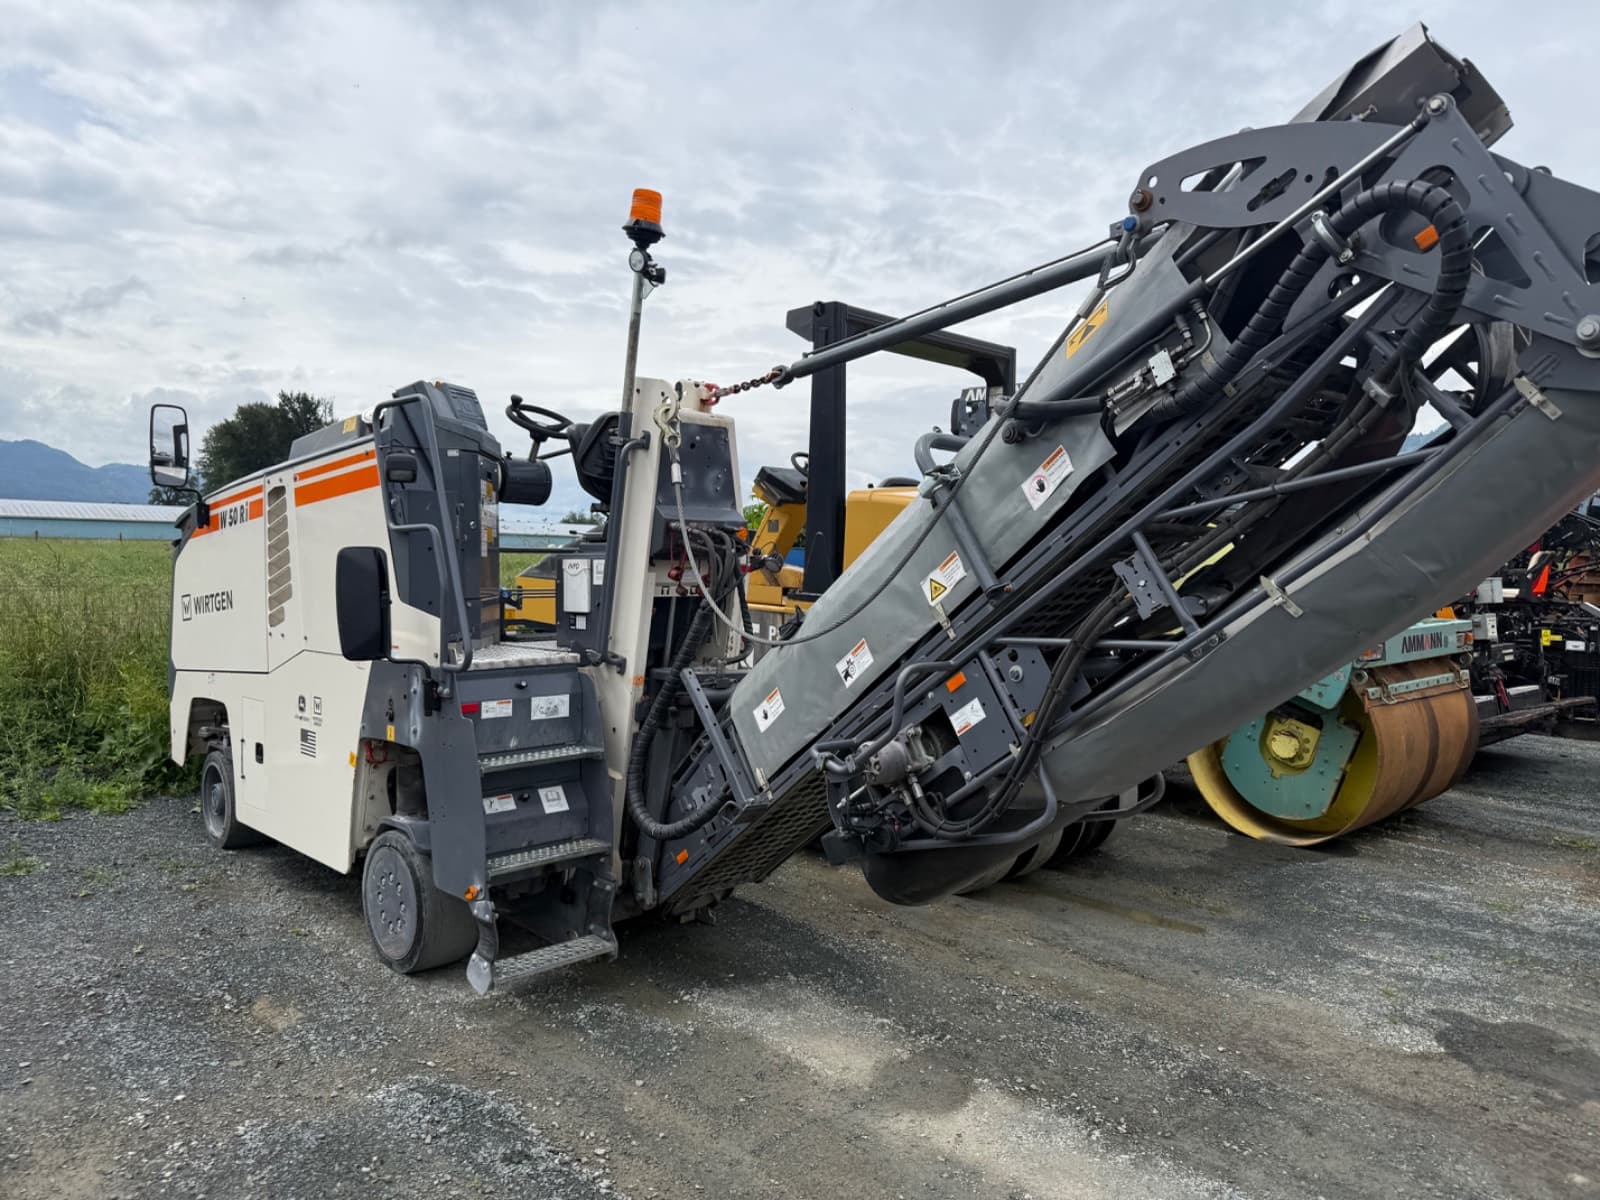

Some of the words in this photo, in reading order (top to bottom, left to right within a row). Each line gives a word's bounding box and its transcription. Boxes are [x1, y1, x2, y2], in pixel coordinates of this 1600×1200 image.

[220, 510, 228, 529] W
[229, 506, 239, 527] 50
[240, 501, 249, 524] Ri
[193, 590, 233, 615] WIRTGEN
[1401, 631, 1443, 654] AMMANN
